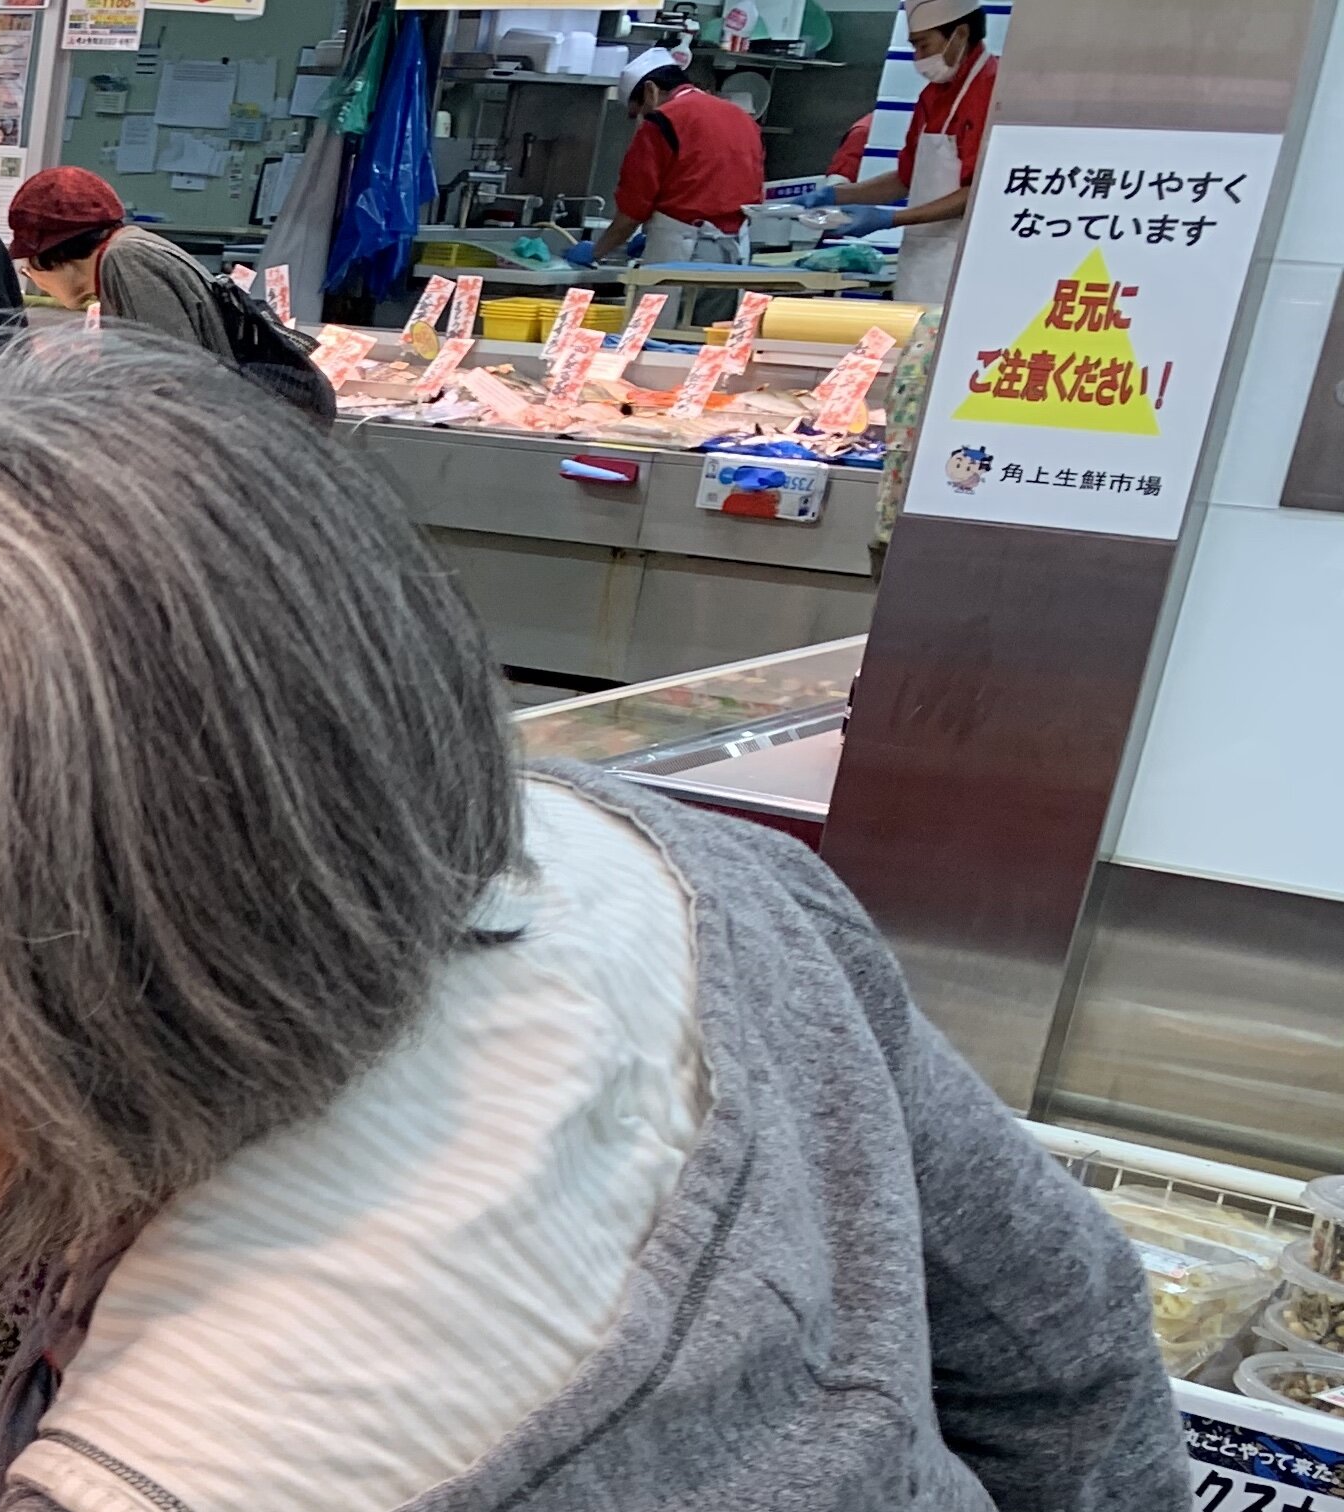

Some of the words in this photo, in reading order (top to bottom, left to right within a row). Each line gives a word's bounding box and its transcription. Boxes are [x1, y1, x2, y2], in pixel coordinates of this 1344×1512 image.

[1003, 165, 1249, 205] 床が滑りやすく
[1009, 208, 1217, 247] なっています
[1044, 278, 1141, 334] 足元に
[999, 462, 1164, 497] 角上生鮮市場
